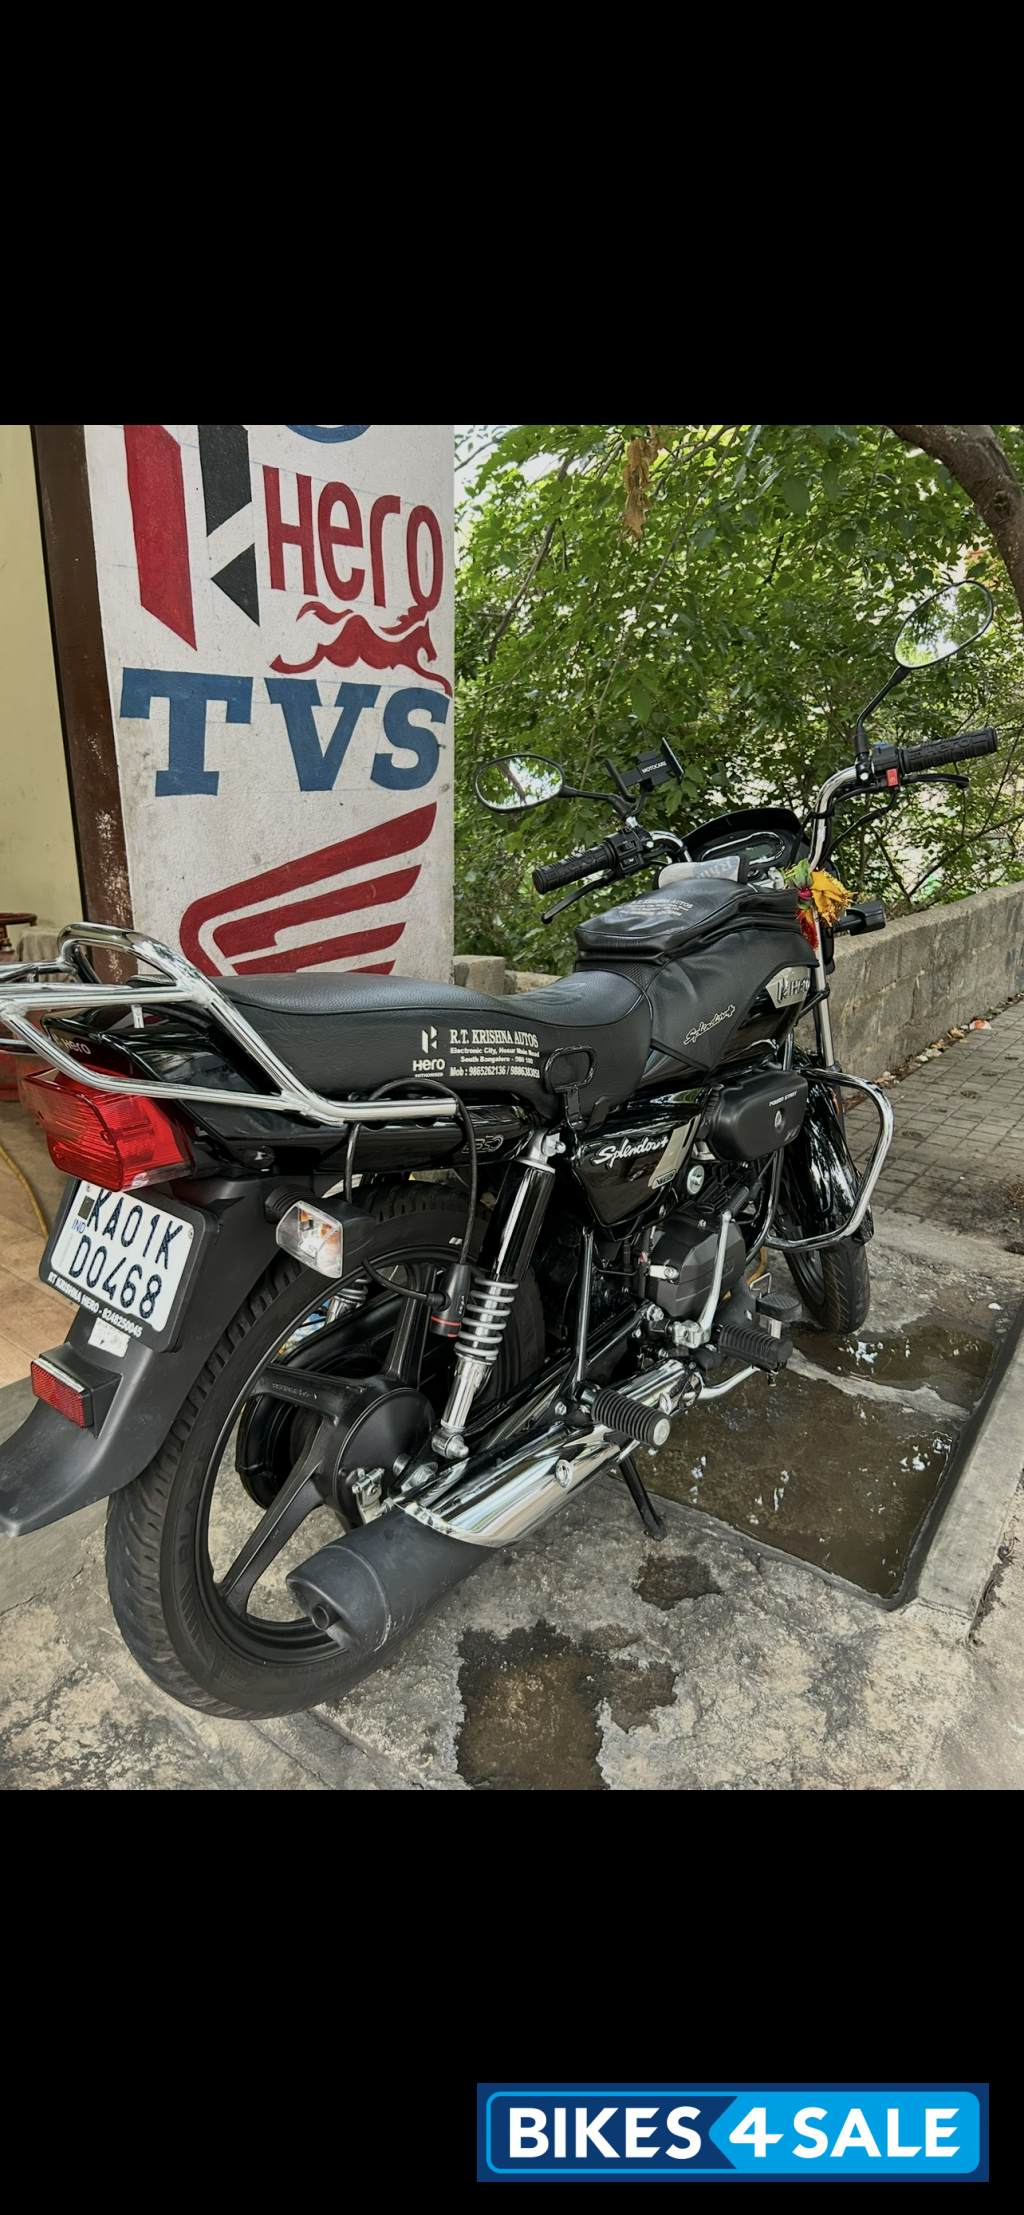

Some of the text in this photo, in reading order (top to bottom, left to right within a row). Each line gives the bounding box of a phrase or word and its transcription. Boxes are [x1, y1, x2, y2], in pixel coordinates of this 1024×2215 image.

[262, 465, 444, 611] Hero
[120, 667, 450, 797] TVS
[641, 760, 668, 773] MOTOCARE
[449, 1029, 539, 1048] R.T. KRISHNA AUTOS
[412, 1058, 446, 1071] Hero
[480, 1055, 510, 1064] Bangalore
[449, 1067, 464, 1077] Mob
[72, 1218, 86, 1234] IND
[87, 1188, 183, 1270] KA01K
[47, 1271, 57, 1283] RT
[55, 1276, 82, 1303] KRISHNA
[80, 1294, 100, 1314] HERO
[101, 1307, 143, 1338] 8248250045
